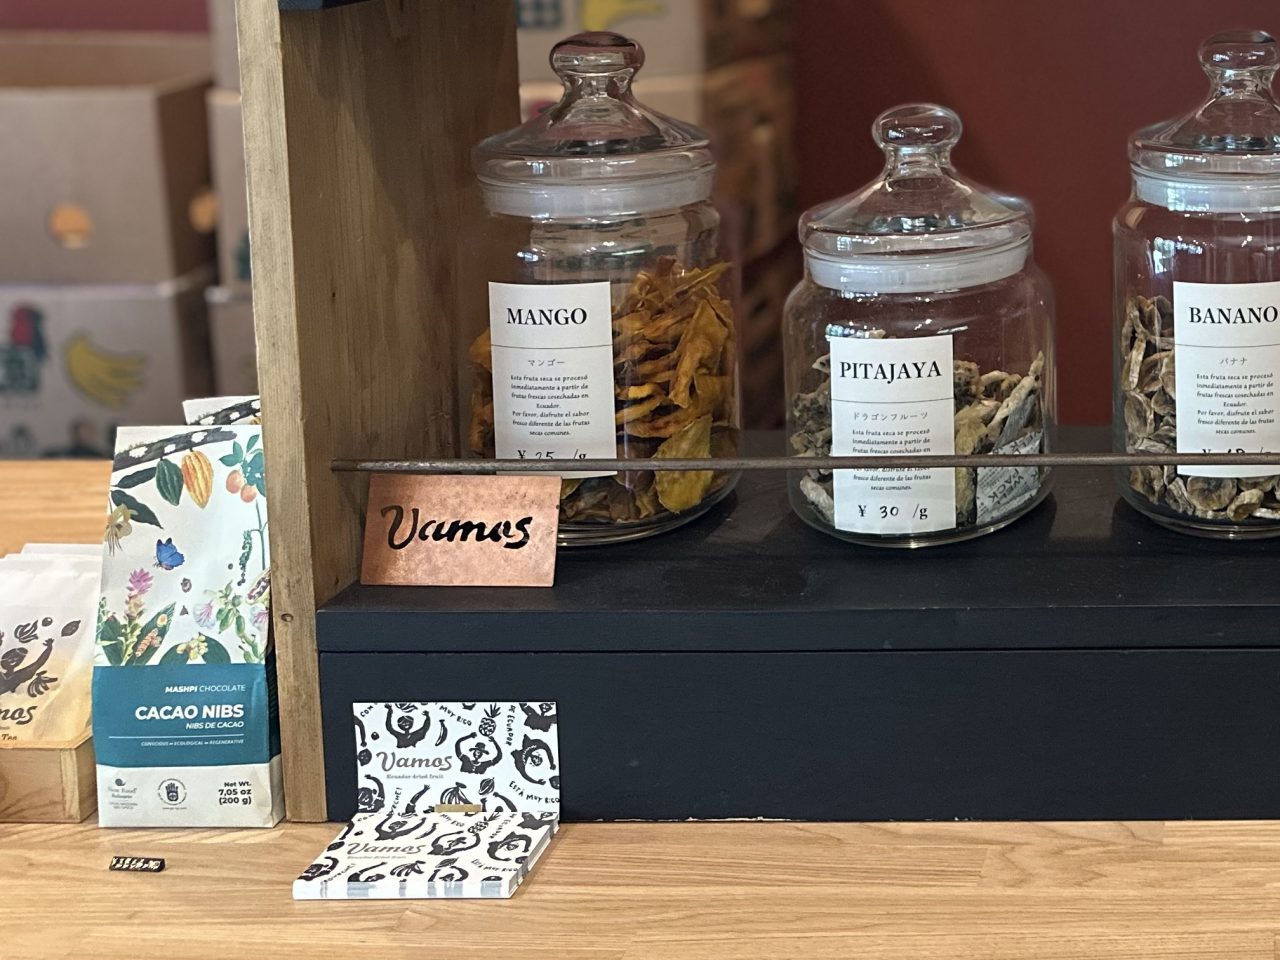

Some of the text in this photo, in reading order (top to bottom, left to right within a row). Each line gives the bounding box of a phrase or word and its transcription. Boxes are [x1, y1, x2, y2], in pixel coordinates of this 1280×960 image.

[507, 308, 587, 325] MANGO
[1189, 306, 1278, 324] BANANO
[1220, 357, 1248, 365] バナナ
[841, 361, 942, 384] PITAJAYA
[854, 410, 928, 423] ドラゴンフルーツ
[880, 506, 899, 518] 30
[381, 505, 533, 549] Vamos
[135, 704, 244, 720] CACAO NIBS
[376, 752, 452, 771] Vamos
[219, 796, 251, 805] (200 g)
